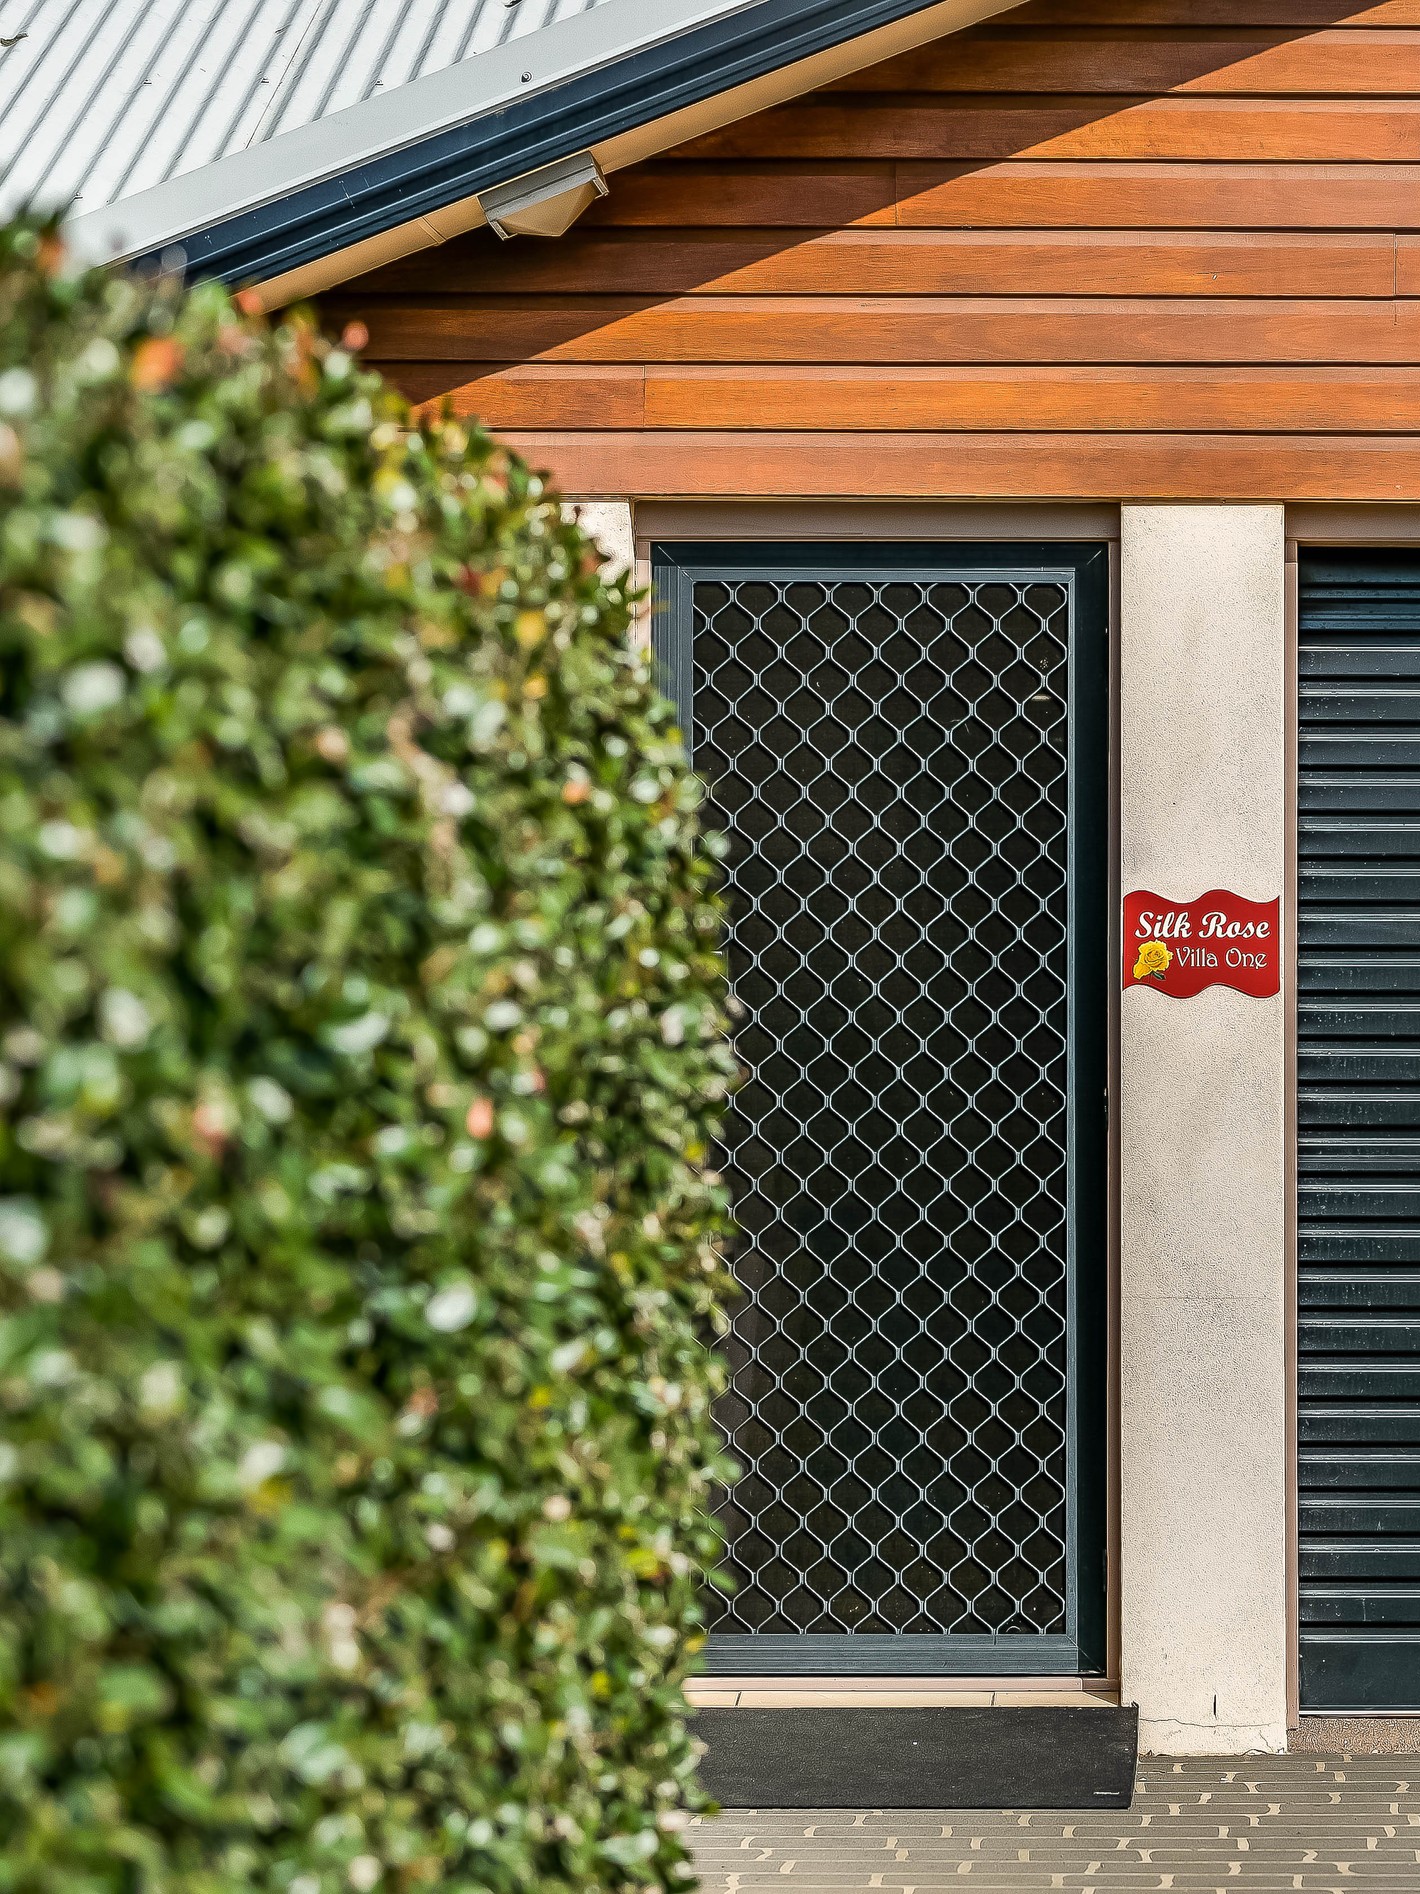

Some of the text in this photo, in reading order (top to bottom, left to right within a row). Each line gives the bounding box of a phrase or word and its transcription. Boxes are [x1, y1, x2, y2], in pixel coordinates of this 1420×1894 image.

[1134, 911, 1271, 938] Silk Rose
[1175, 946, 1268, 969] Villa One
